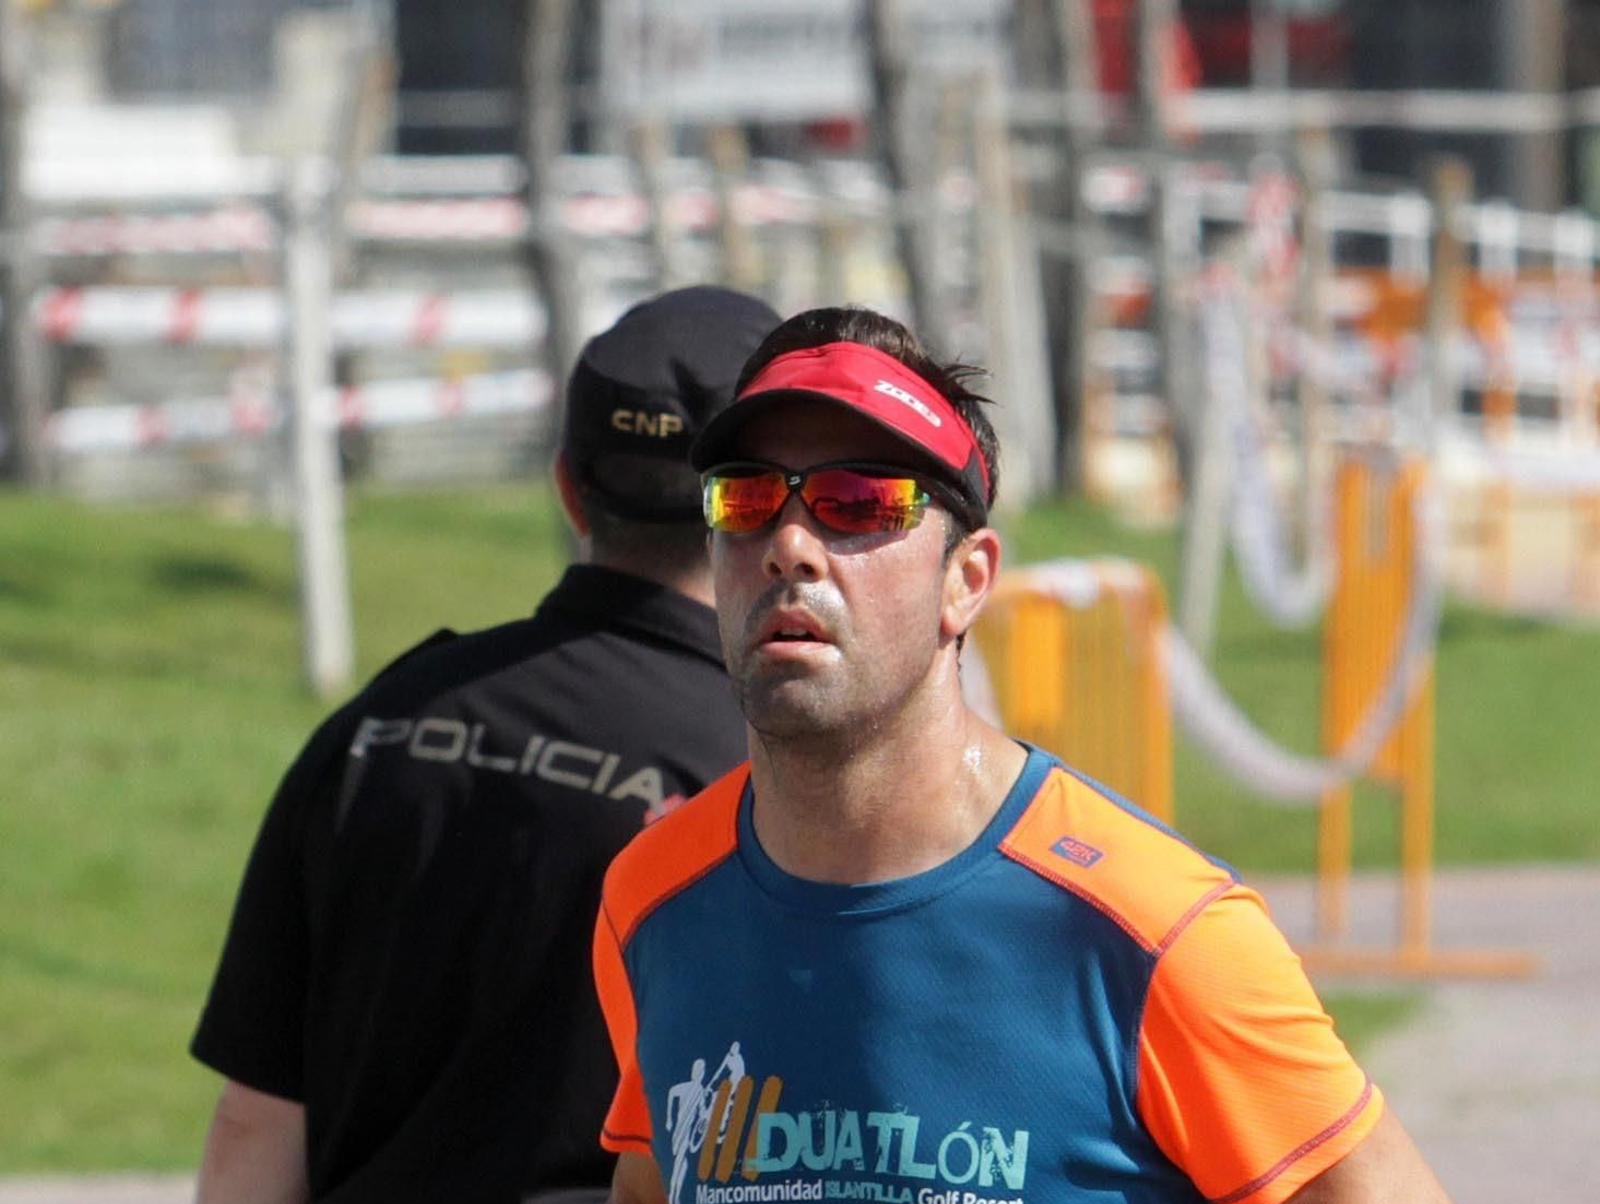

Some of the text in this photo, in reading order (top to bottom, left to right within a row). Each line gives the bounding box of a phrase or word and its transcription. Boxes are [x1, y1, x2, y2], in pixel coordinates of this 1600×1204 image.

[611, 409, 683, 438] CNP
[350, 717, 666, 816] POLICIA
[746, 1106, 1029, 1190] DUATLÓN
[696, 1179, 822, 1204] Mancomunidad
[825, 1181, 914, 1204] ISLANTILLA
